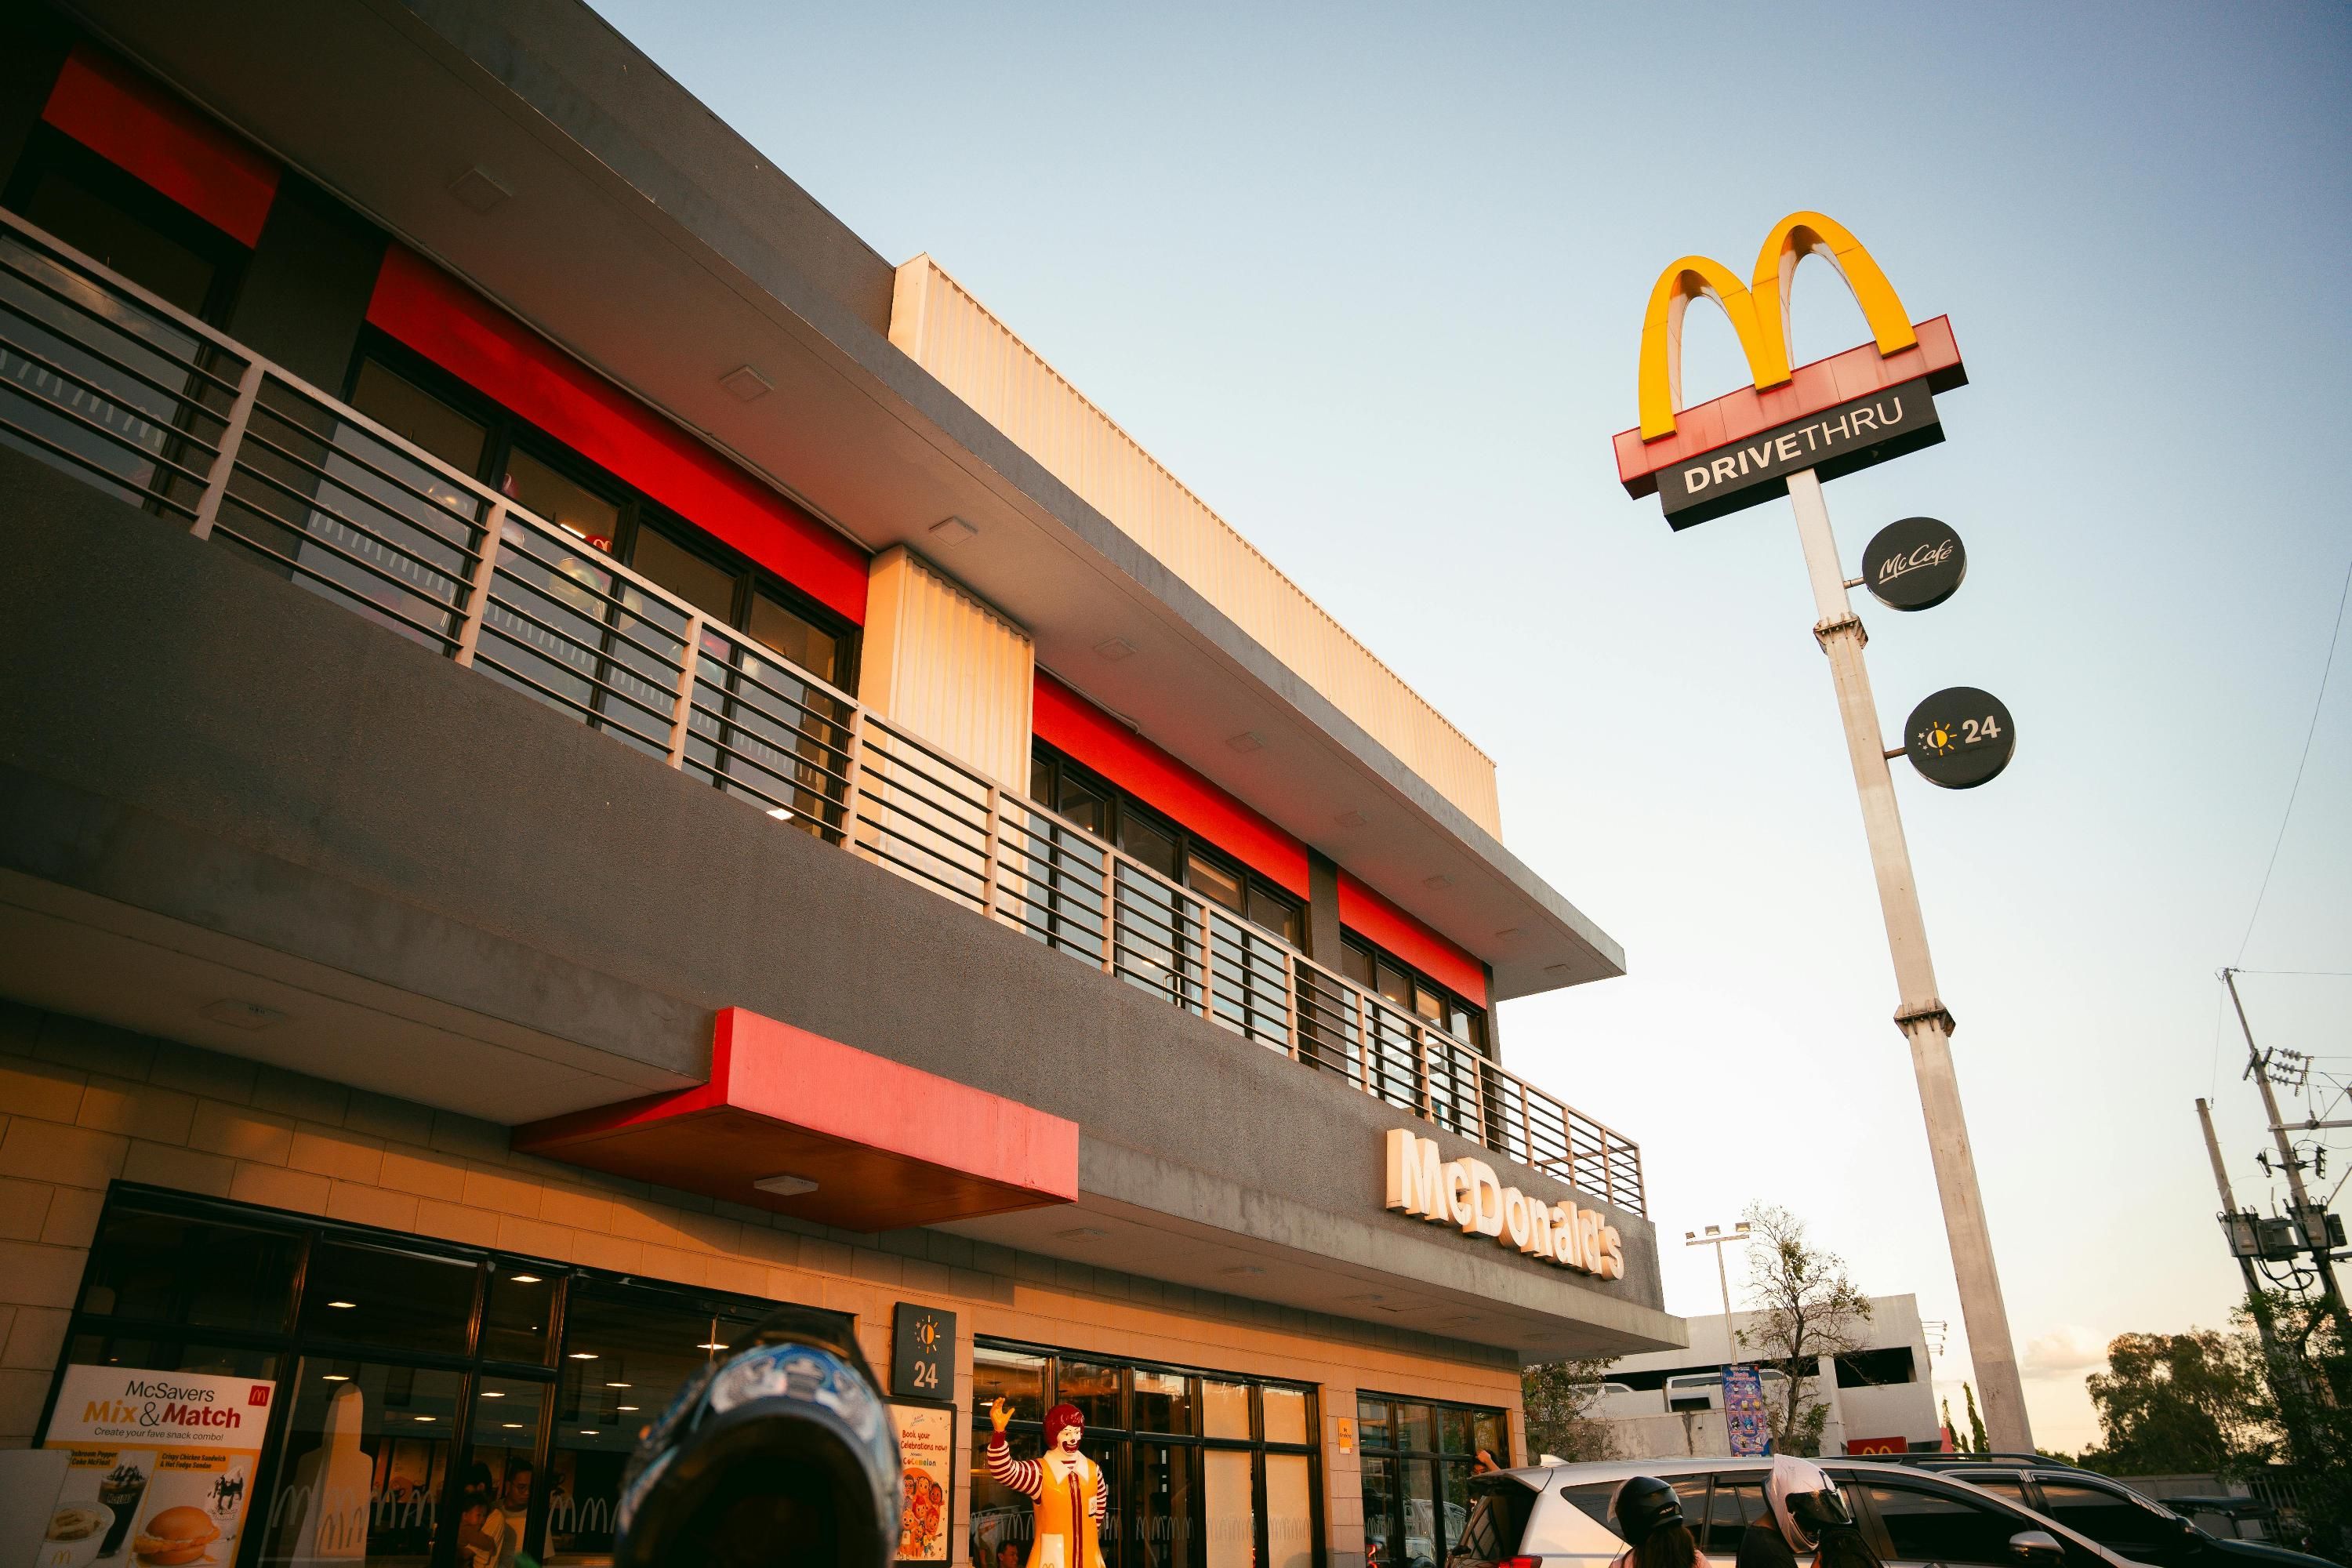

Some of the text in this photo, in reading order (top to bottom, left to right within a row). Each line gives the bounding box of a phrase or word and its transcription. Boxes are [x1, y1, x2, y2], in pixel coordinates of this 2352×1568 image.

[1962, 715, 2002, 744] 24
[1386, 1127, 1624, 1281] McDonald's
[913, 1360, 938, 1389] 24
[125, 1380, 215, 1402] McSavers
[83, 1399, 241, 1428] Mix & Match
[94, 1427, 125, 1436] Create
[147, 1429, 165, 1438] fave
[166, 1430, 192, 1439] snack
[901, 1440, 934, 1450] Celebrations
[902, 1429, 916, 1439] Book
